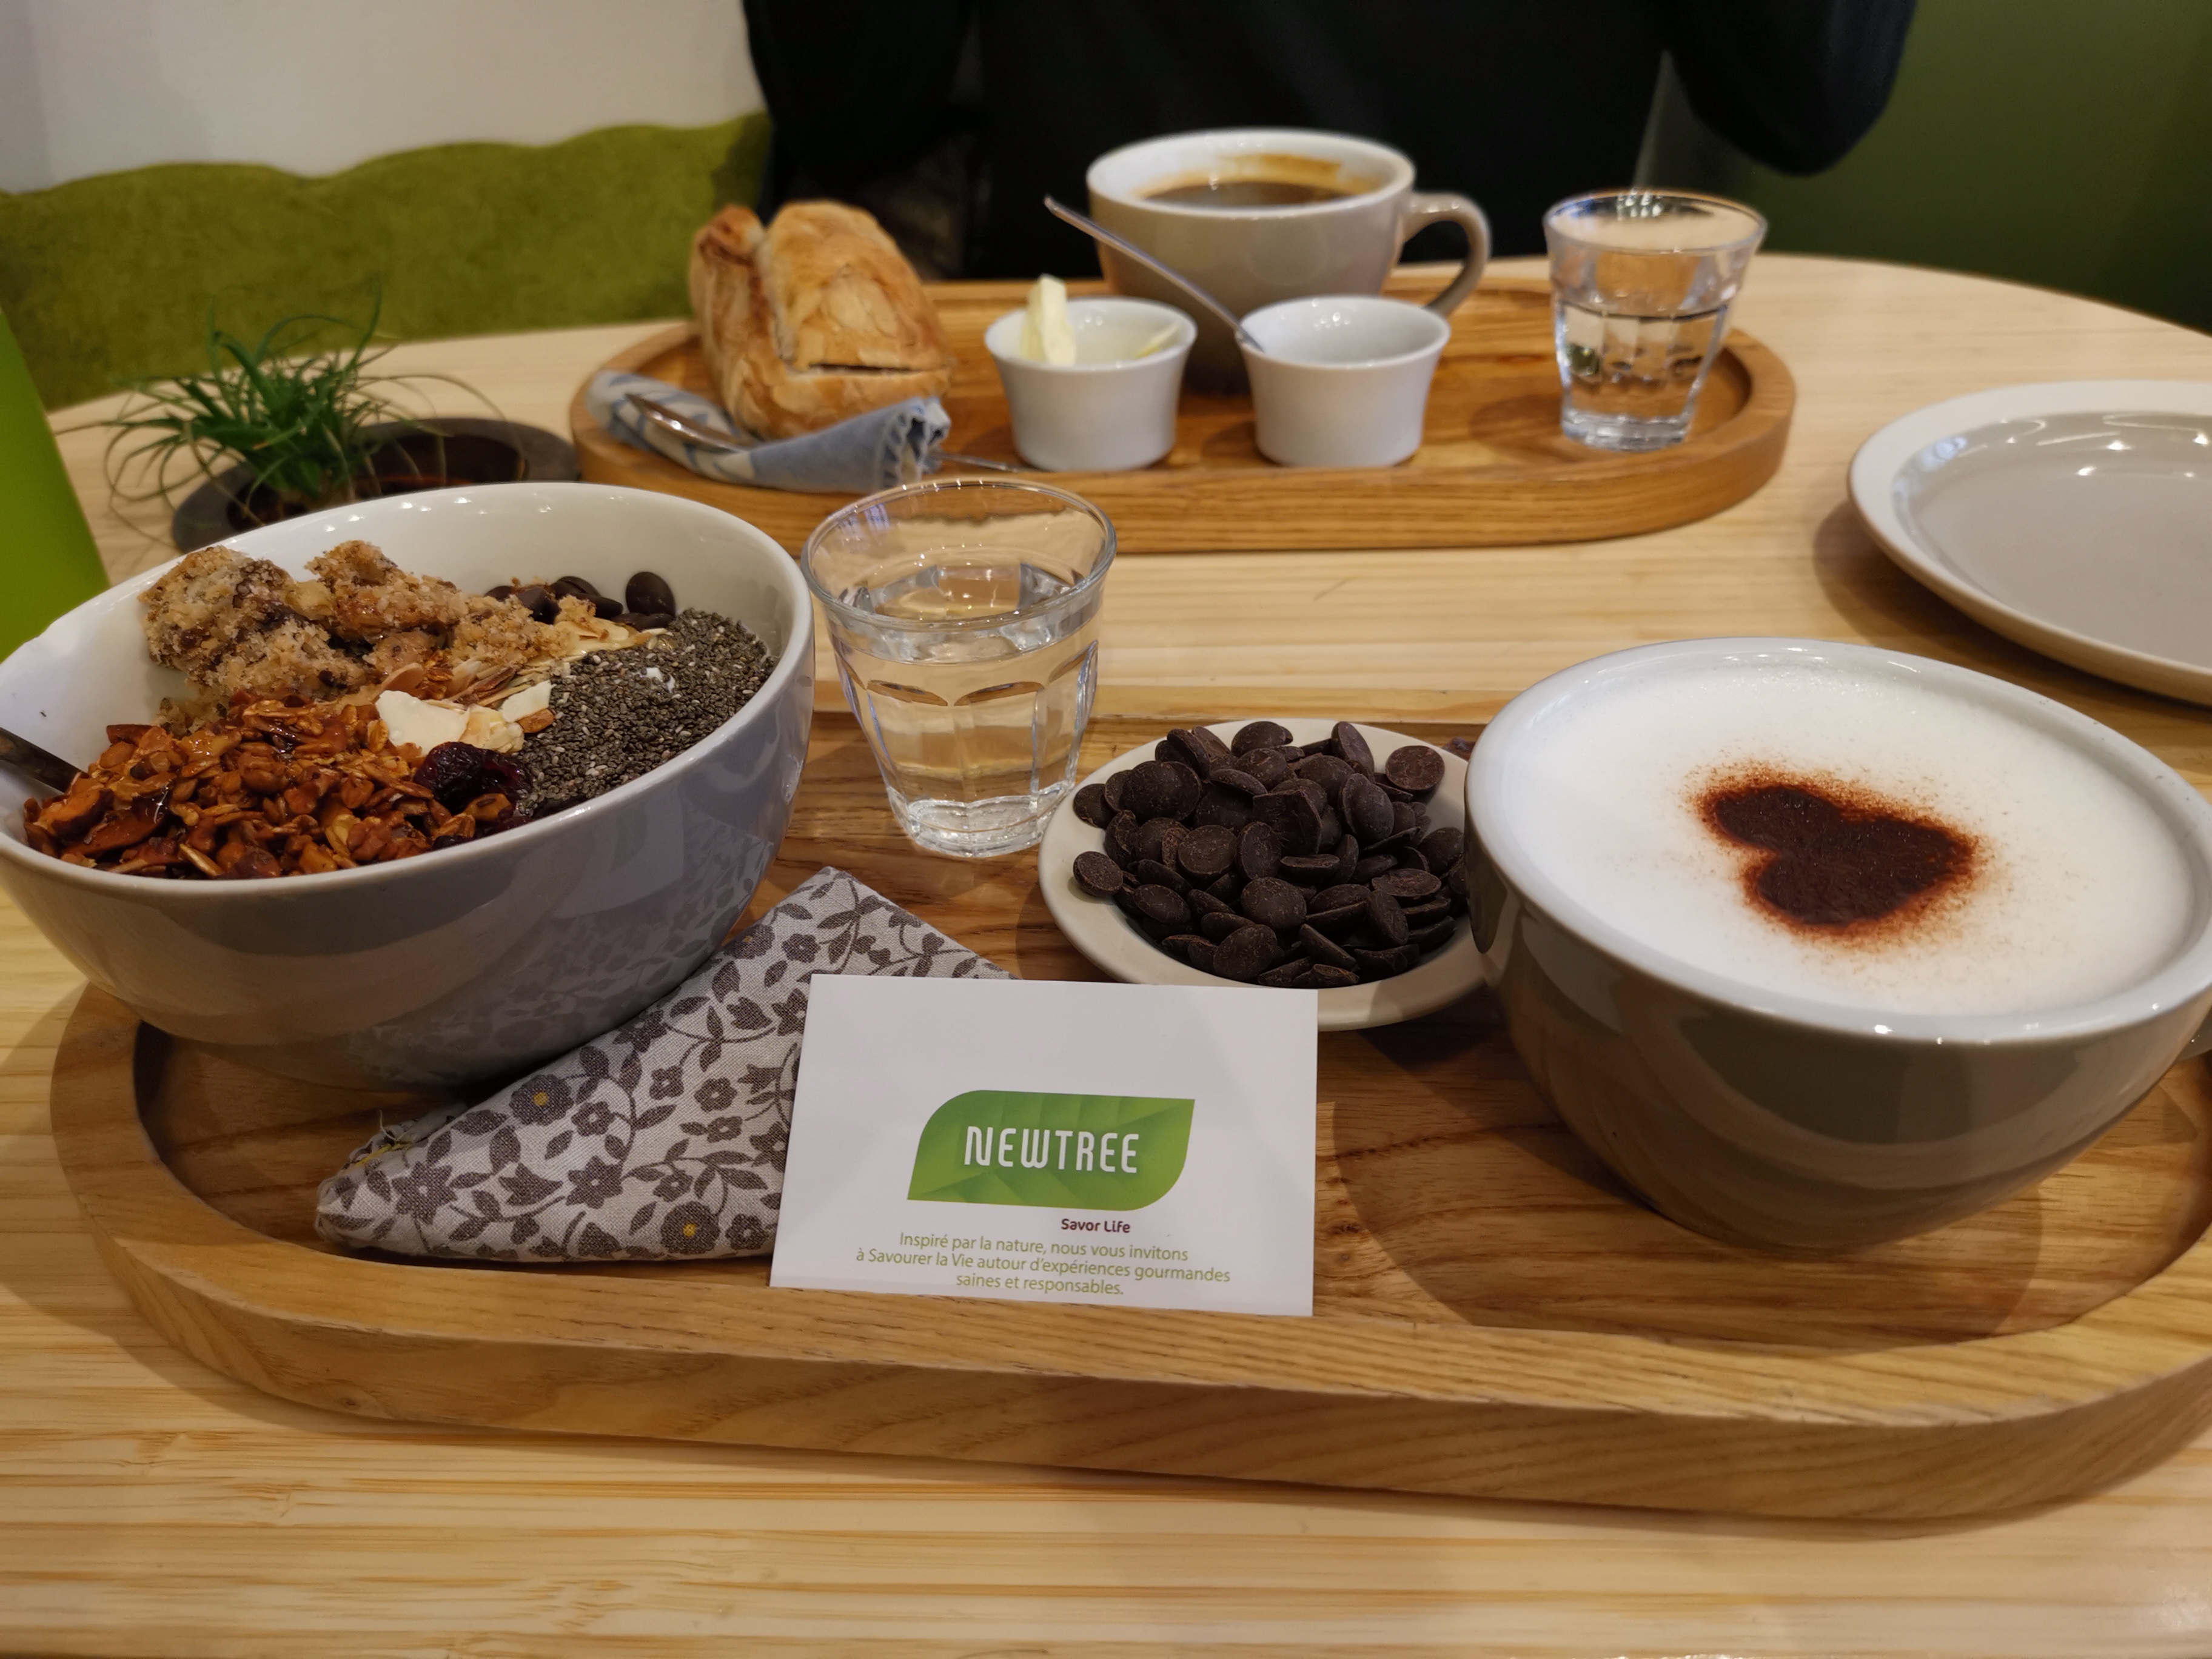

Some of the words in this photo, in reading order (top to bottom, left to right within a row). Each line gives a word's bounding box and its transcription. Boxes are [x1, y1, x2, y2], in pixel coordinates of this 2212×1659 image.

[964, 1126, 1139, 1173] NEWTREE
[1061, 1218, 1101, 1232] Savor
[1104, 1220, 1131, 1233] Life
[899, 1232, 948, 1250] Inspiré
[951, 1238, 977, 1252] par
[979, 1235, 992, 1250] la
[996, 1239, 1047, 1255] nature,
[1051, 1243, 1087, 1256] nous
[1091, 1245, 1126, 1258] vous
[1129, 1244, 1188, 1262] invitons
[856, 1247, 865, 1262] à
[868, 1248, 933, 1265] Savourer
[936, 1252, 948, 1267] la
[951, 1253, 974, 1268] Vie
[976, 1257, 1027, 1270] autour
[1134, 1267, 1230, 1282] gourmandes
[956, 1274, 1001, 1289] saines
[1005, 1276, 1020, 1289] et
[1023, 1279, 1124, 1295] responsables.
